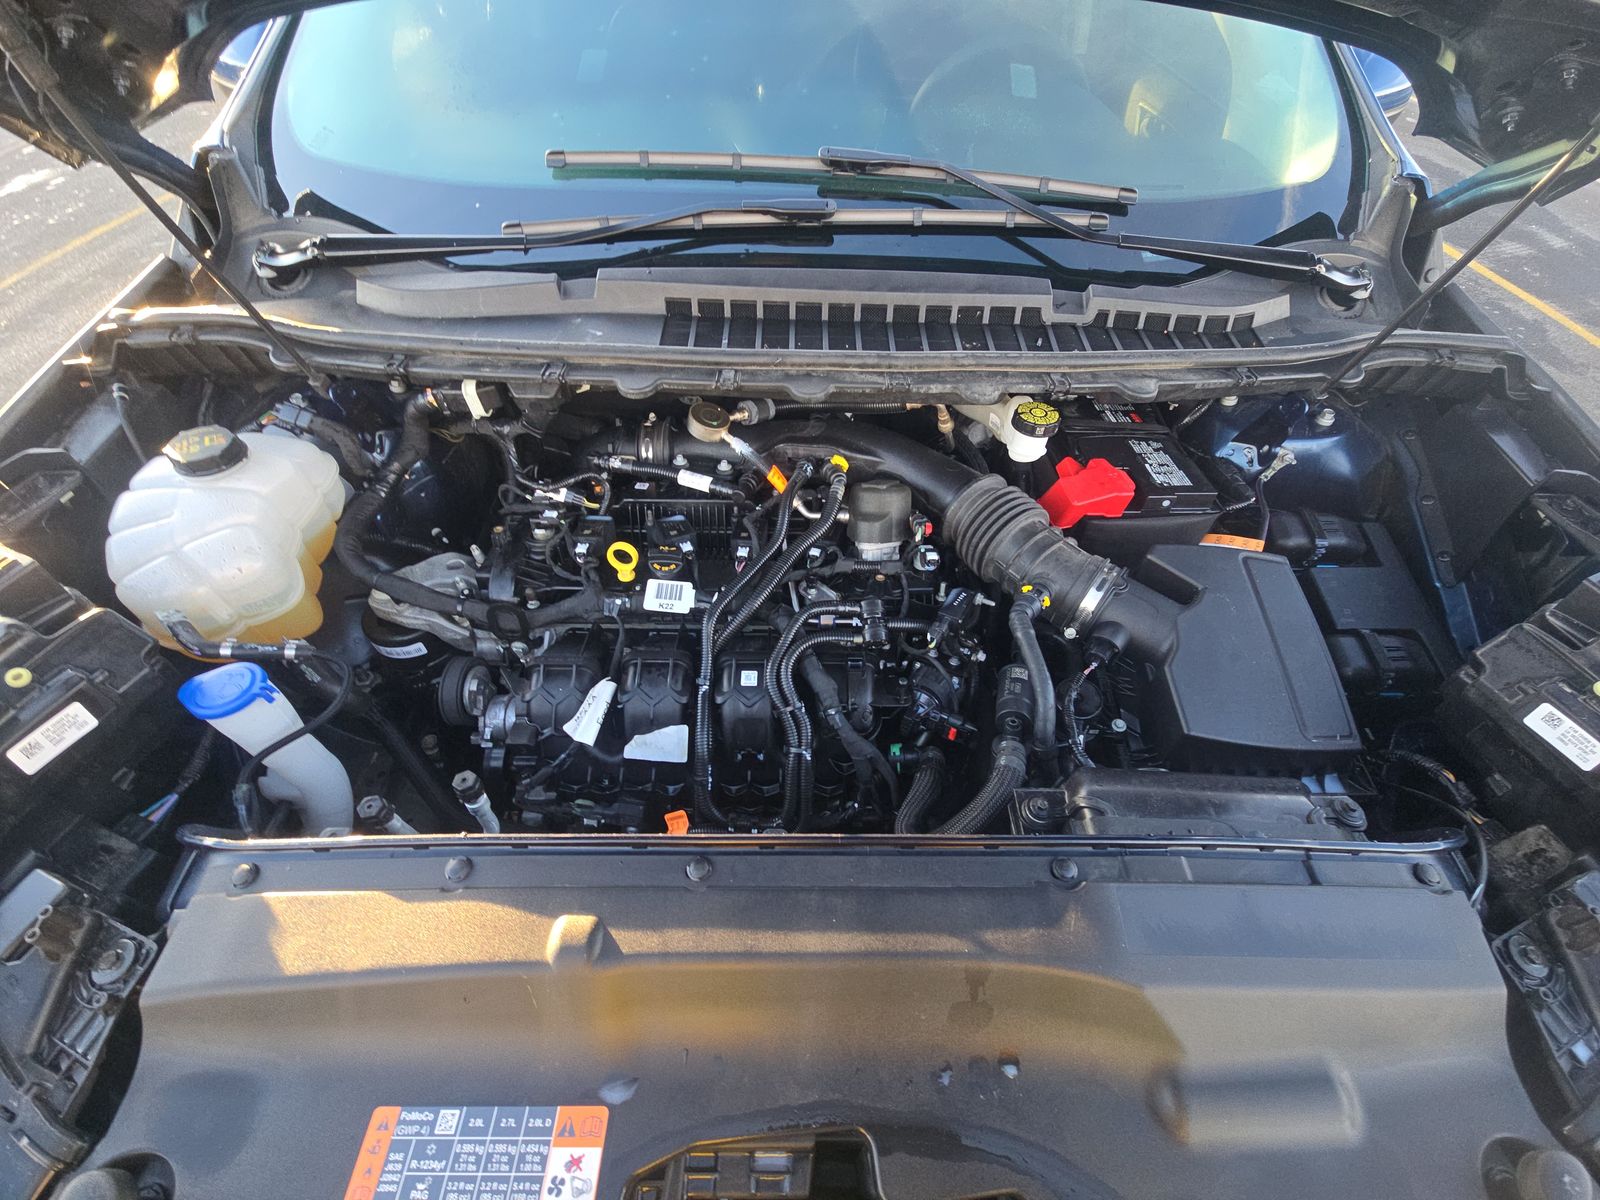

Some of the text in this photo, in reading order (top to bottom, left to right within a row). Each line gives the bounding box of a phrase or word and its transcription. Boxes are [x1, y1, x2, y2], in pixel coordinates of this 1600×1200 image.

[658, 602, 674, 610] K22
[400, 1111, 435, 1121] FoMoCo
[468, 1118, 485, 1127] 2.0L
[500, 1118, 516, 1127] 2.7L
[545, 1118, 552, 1127] D
[475, 1143, 485, 1155] kg
[507, 1143, 517, 1155] kg
[539, 1143, 549, 1155] kg
[388, 1152, 405, 1161] SAE
[409, 1190, 429, 1200] PAG
